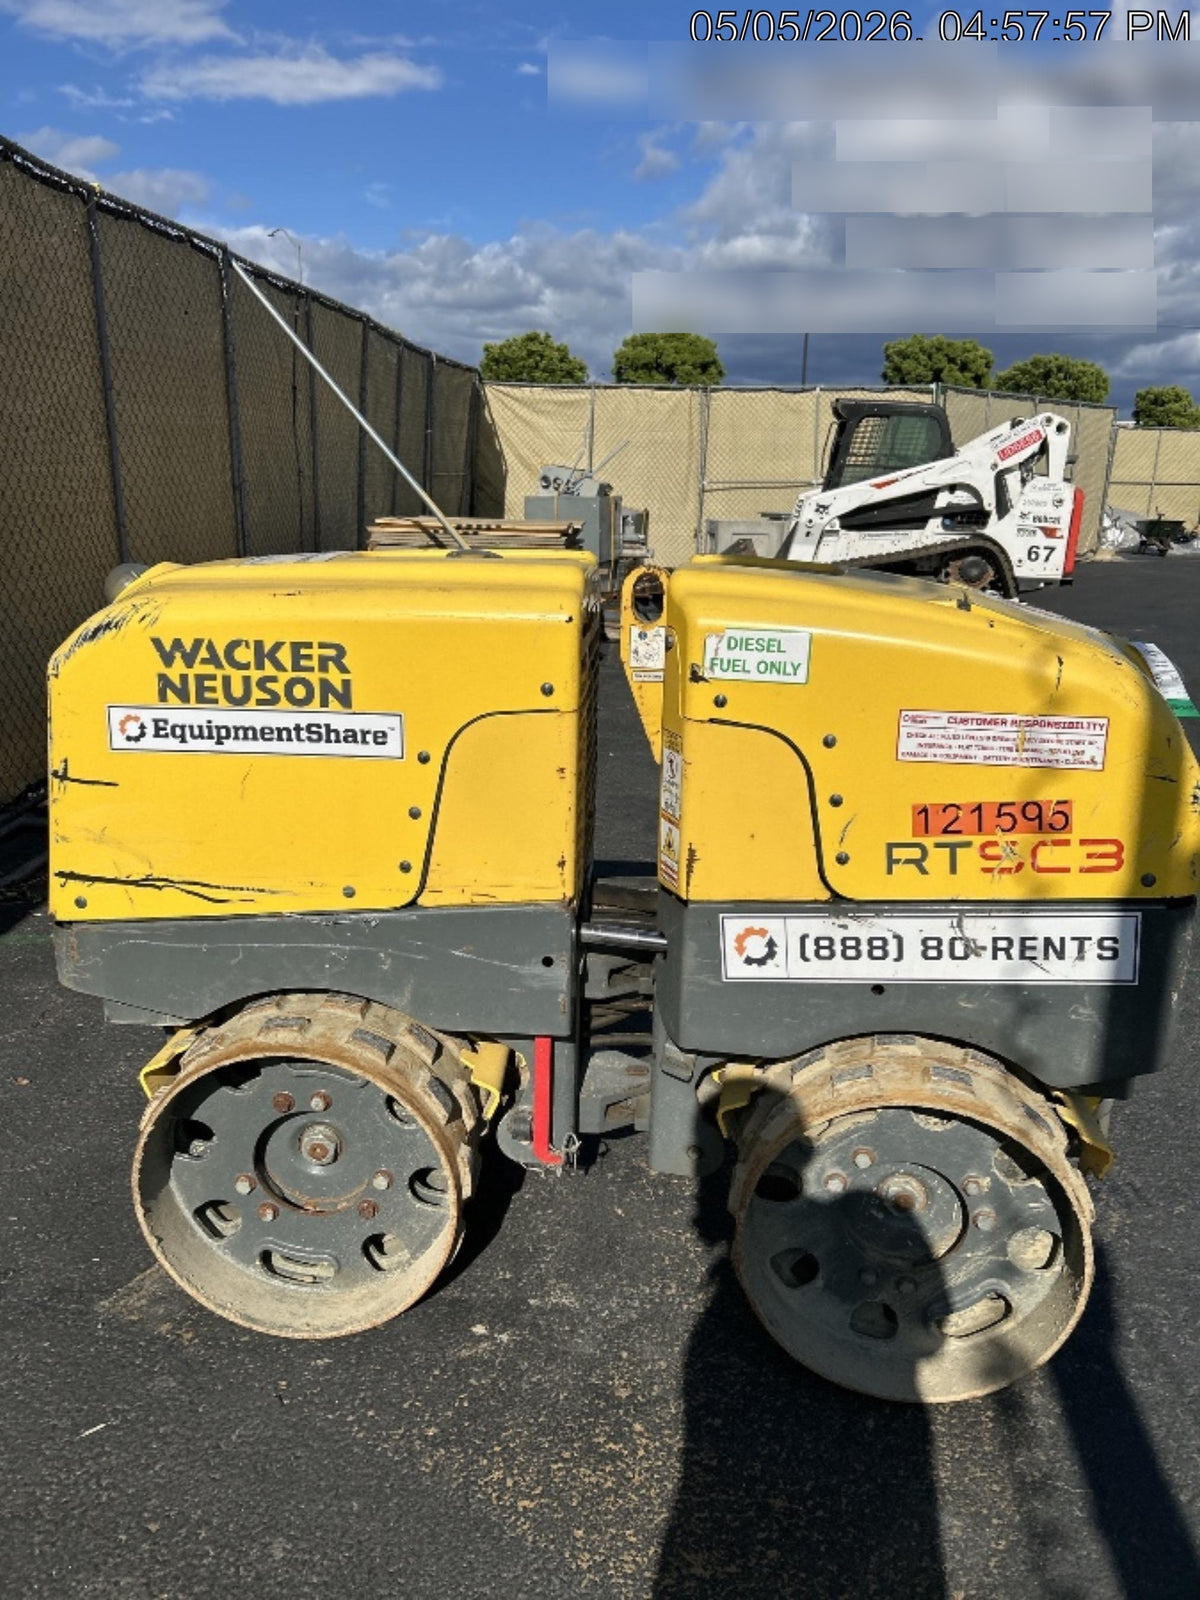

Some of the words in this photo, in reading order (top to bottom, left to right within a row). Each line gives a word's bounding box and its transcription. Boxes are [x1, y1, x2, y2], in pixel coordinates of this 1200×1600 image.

[1026, 545, 1056, 563] 67
[150, 637, 351, 673] WACKER
[727, 635, 786, 653] DIESEL
[710, 657, 750, 674] FUEL
[757, 660, 802, 677] ONLY
[157, 673, 353, 708] NEUSON
[947, 716, 1008, 728] CUSTOMER
[916, 800, 1070, 835] 121595
[798, 933, 904, 962] (888)
